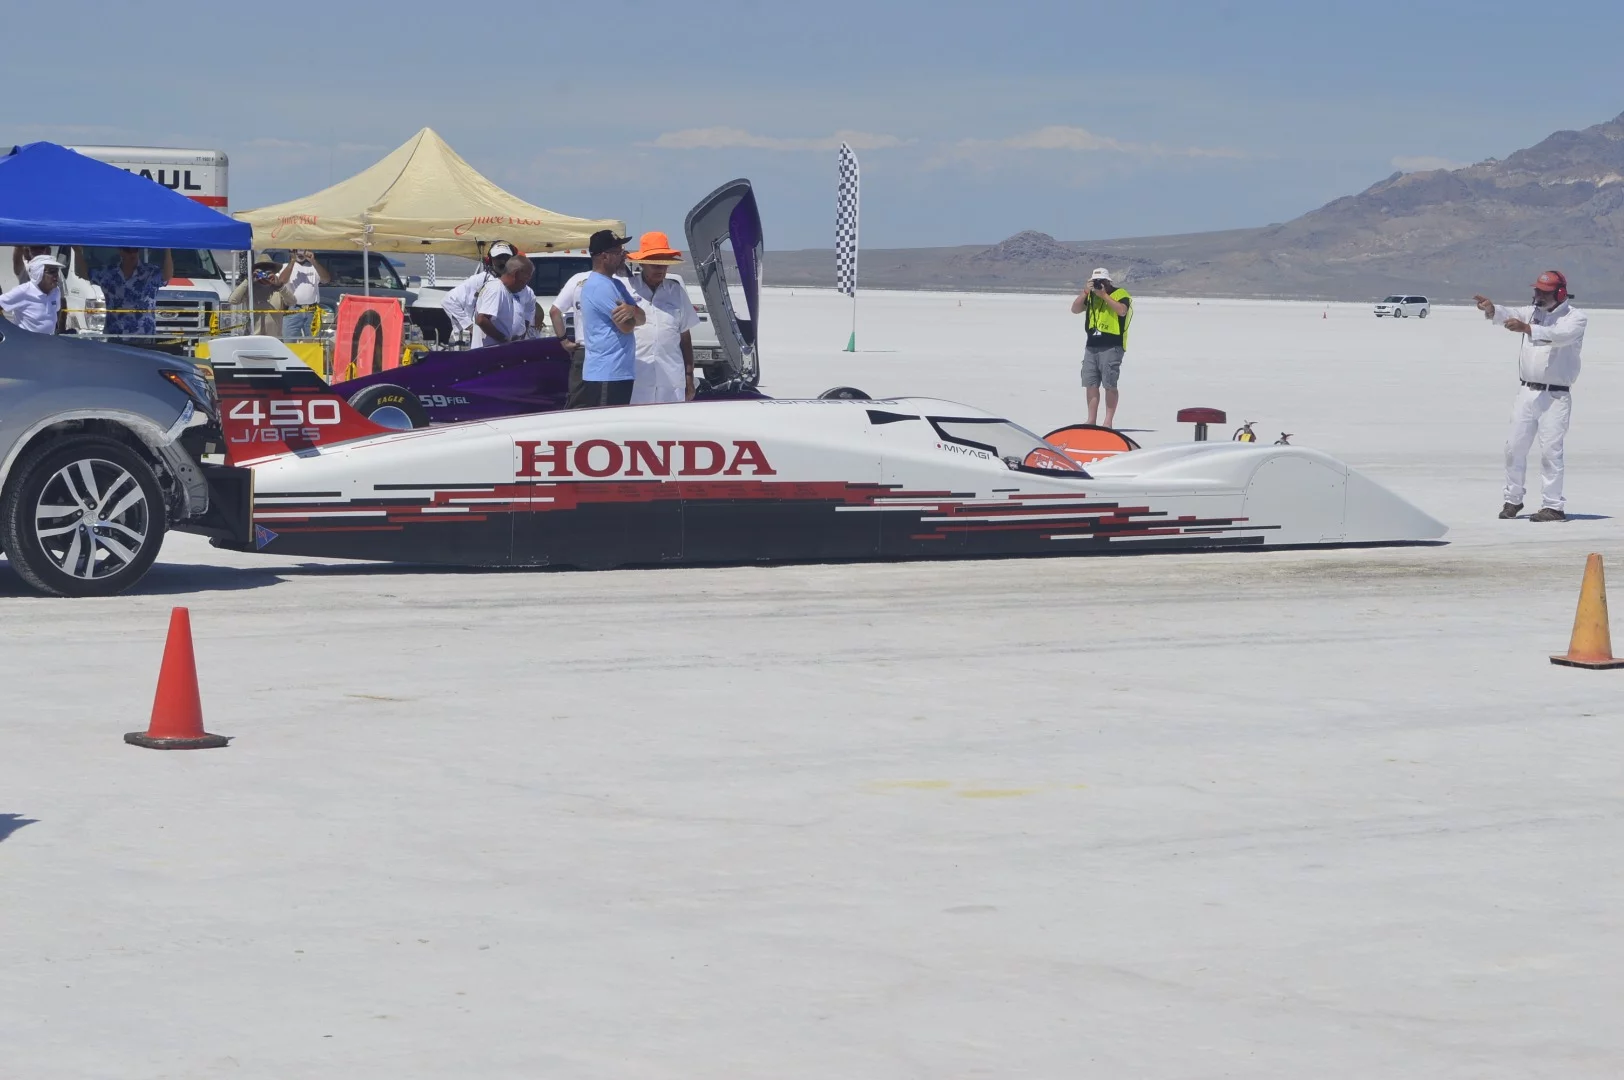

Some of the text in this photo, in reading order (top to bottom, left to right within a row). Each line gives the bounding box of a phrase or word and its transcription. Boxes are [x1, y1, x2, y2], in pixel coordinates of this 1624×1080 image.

[124, 168, 202, 190] AUL
[376, 395, 405, 406] EAGLE
[418, 394, 448, 408] 59
[229, 399, 341, 426] 450
[230, 427, 321, 443] J/BFS
[514, 438, 778, 478] HONDA
[943, 443, 990, 461] MIYAGI
